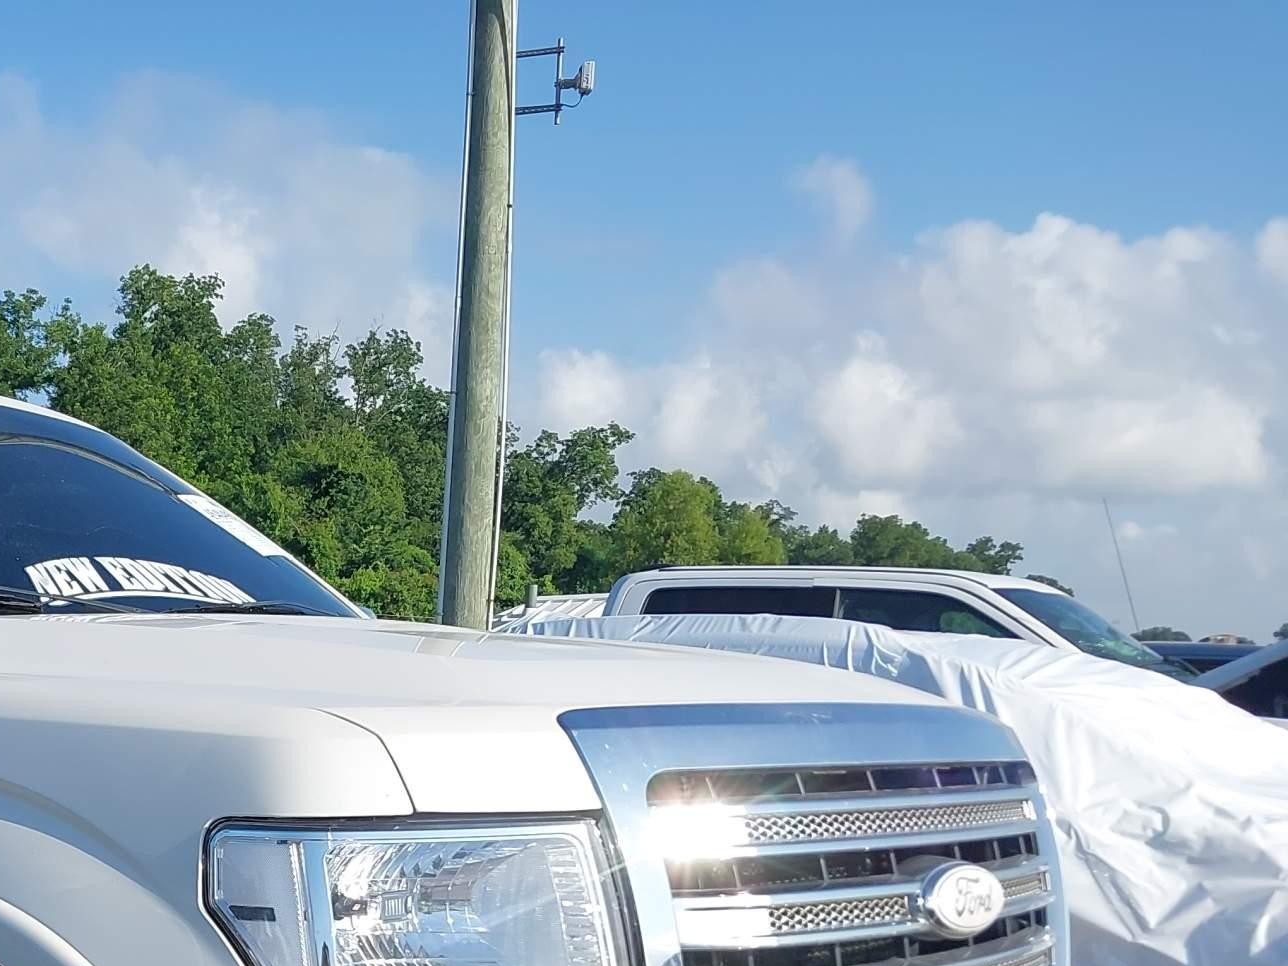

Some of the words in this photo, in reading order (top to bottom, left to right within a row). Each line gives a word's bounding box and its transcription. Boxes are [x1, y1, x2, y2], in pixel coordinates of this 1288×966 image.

[24, 557, 110, 597] NEW
[94, 557, 258, 604] EDITION
[955, 876, 992, 918] Ford
